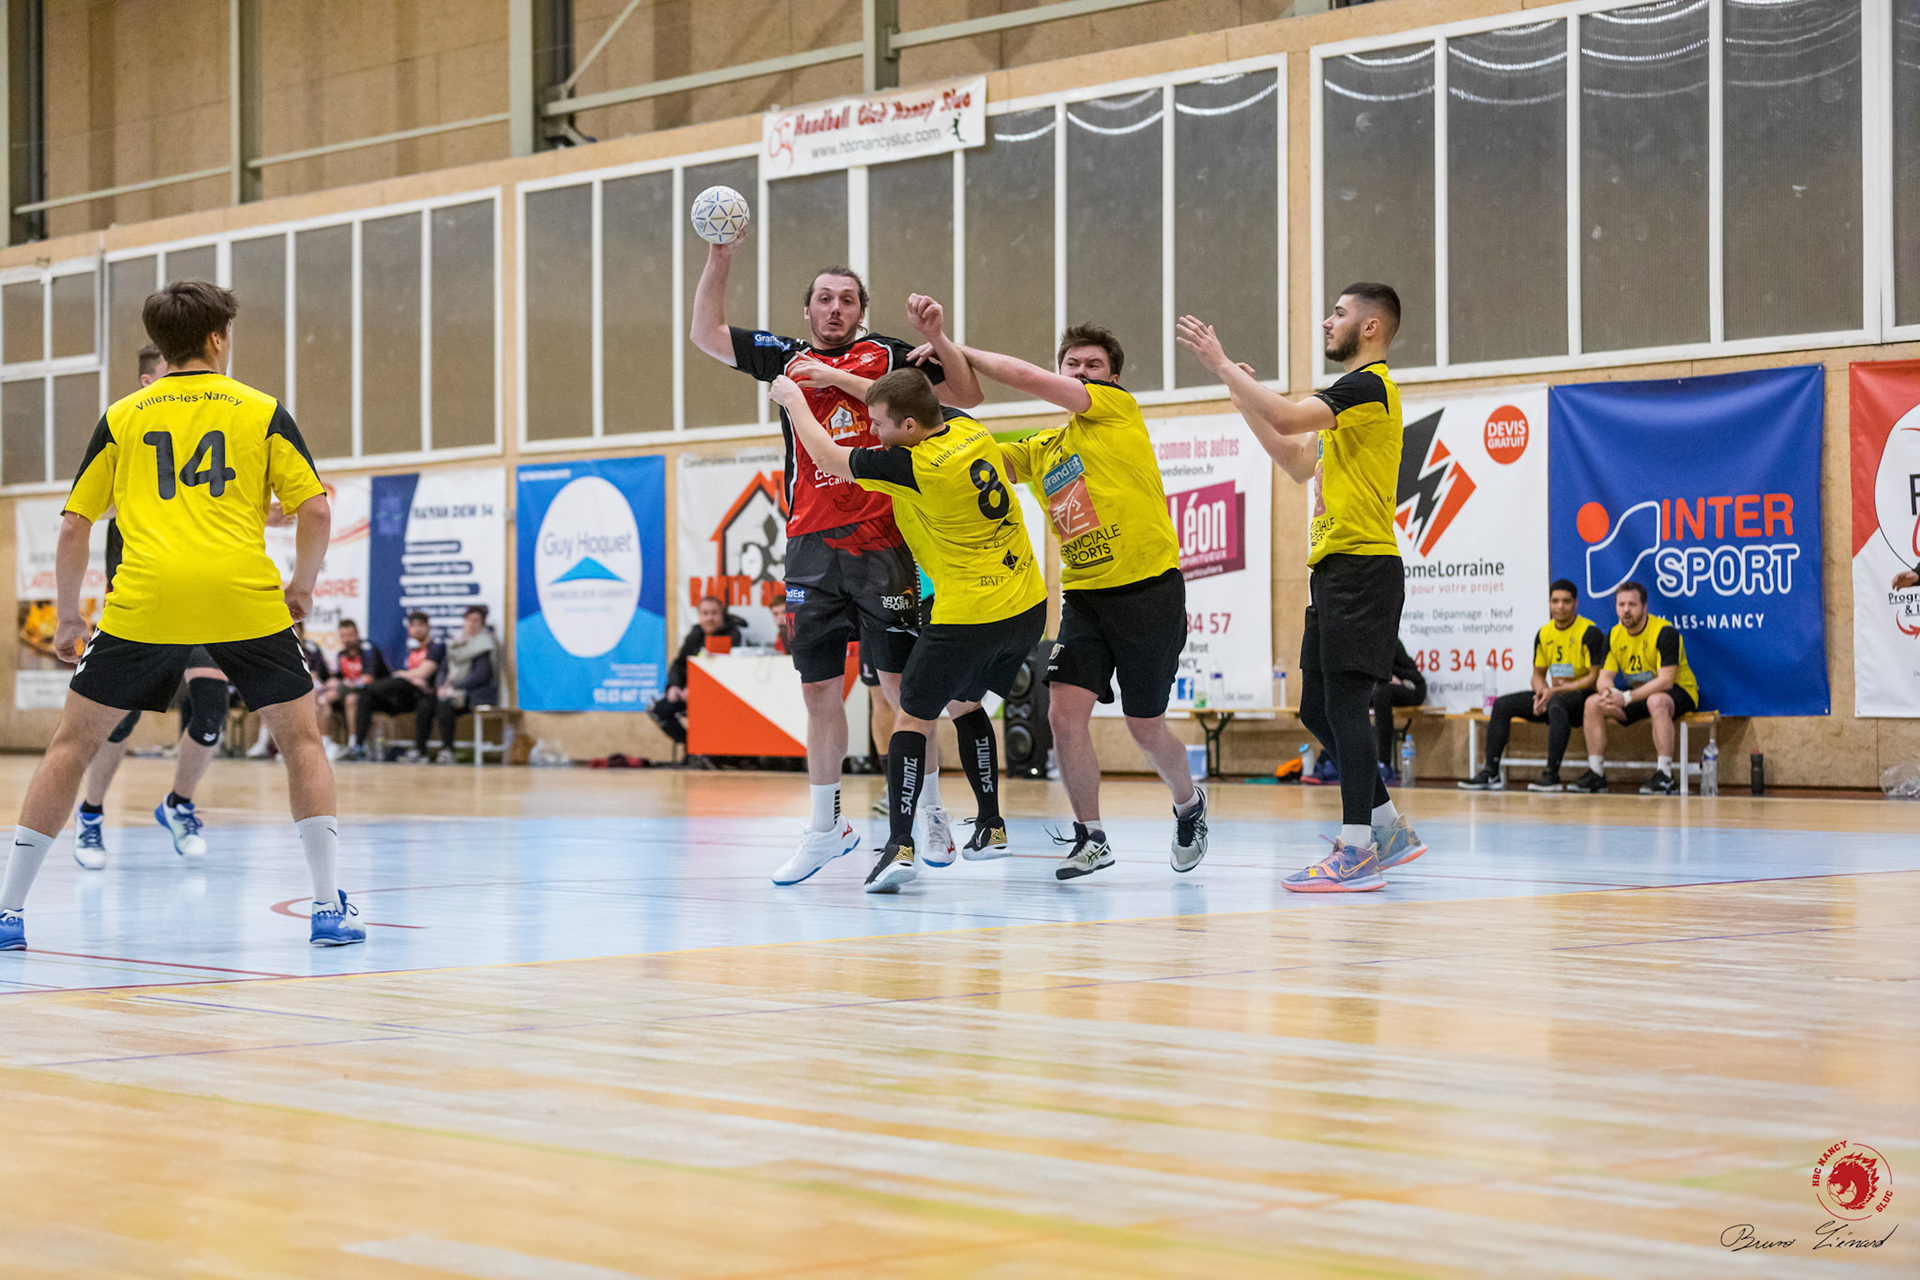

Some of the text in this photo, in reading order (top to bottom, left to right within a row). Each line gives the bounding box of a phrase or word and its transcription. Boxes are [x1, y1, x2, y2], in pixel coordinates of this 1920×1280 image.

[135, 391, 243, 411] Villers-les-Nancy
[1487, 420, 1526, 437] DEVIS
[1210, 434, 1239, 456] autres
[1487, 436, 1525, 449] GRATUIT
[143, 430, 236, 500] 14
[969, 459, 1009, 520] 8
[1661, 493, 1794, 541] INTER
[543, 531, 632, 558] Guy Hoquet
[1655, 543, 1800, 597] SPORT
[1411, 580, 1504, 596] pour votre projet
[1888, 592, 1920, 604] Progr
[1210, 613, 1231, 633] 57
[1432, 608, 1482, 621] Dépannage
[1491, 607, 1513, 618] Neuf
[1410, 623, 1514, 636] Diagnostic Interphone
[1415, 648, 1514, 672] 48 34 46
[1556, 646, 1562, 661] 5
[1630, 654, 1642, 671] 23
[975, 736, 994, 793] SALMING
[901, 757, 918, 815] SALMING
